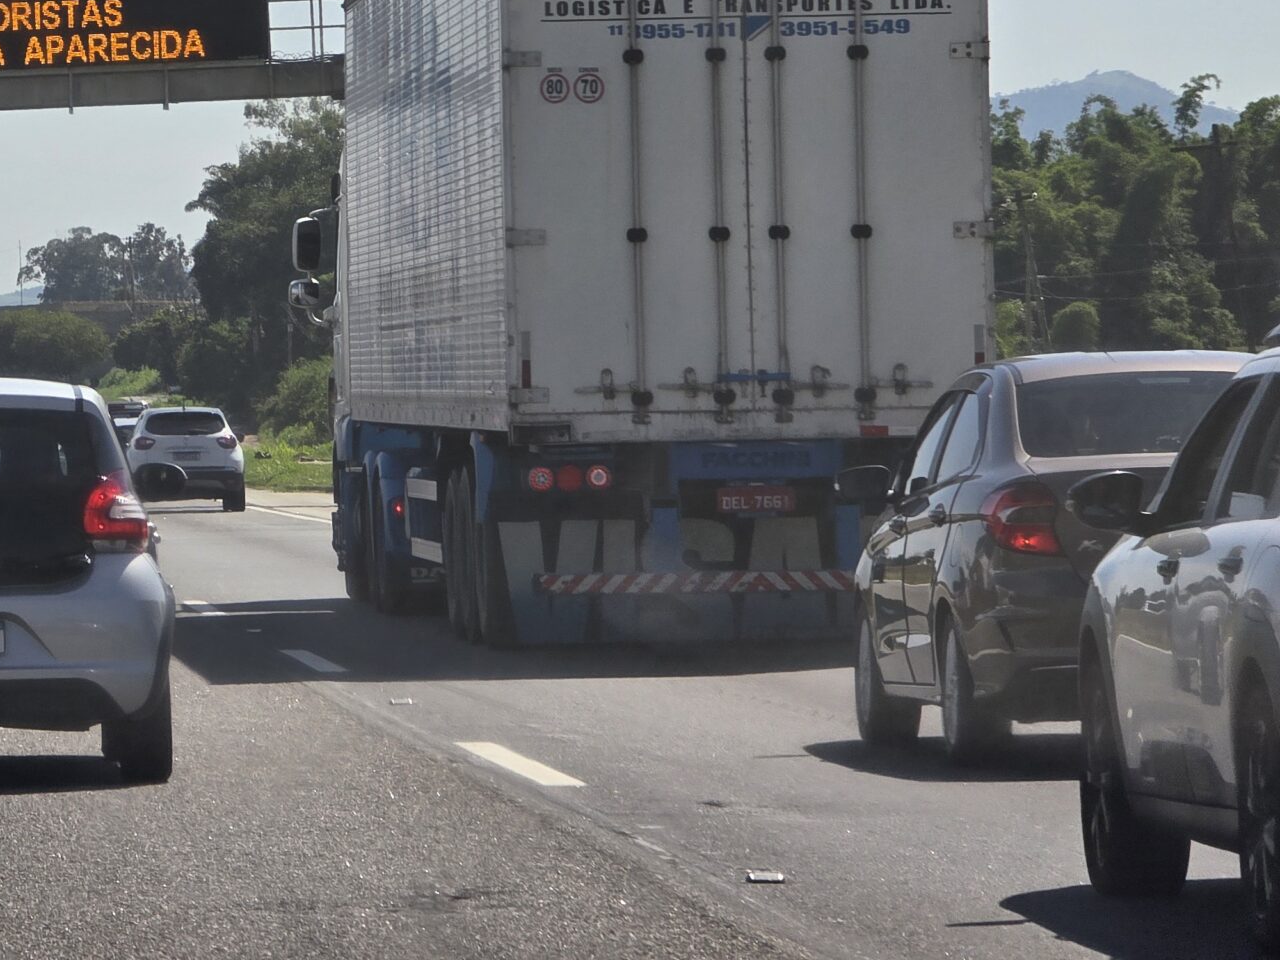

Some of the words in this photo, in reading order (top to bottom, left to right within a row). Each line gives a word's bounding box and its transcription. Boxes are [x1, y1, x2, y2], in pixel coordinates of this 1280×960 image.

[607, 24, 624, 36] 11
[24, 28, 206, 66] APARECIDA
[546, 78, 564, 95] 80
[580, 78, 599, 95] 70
